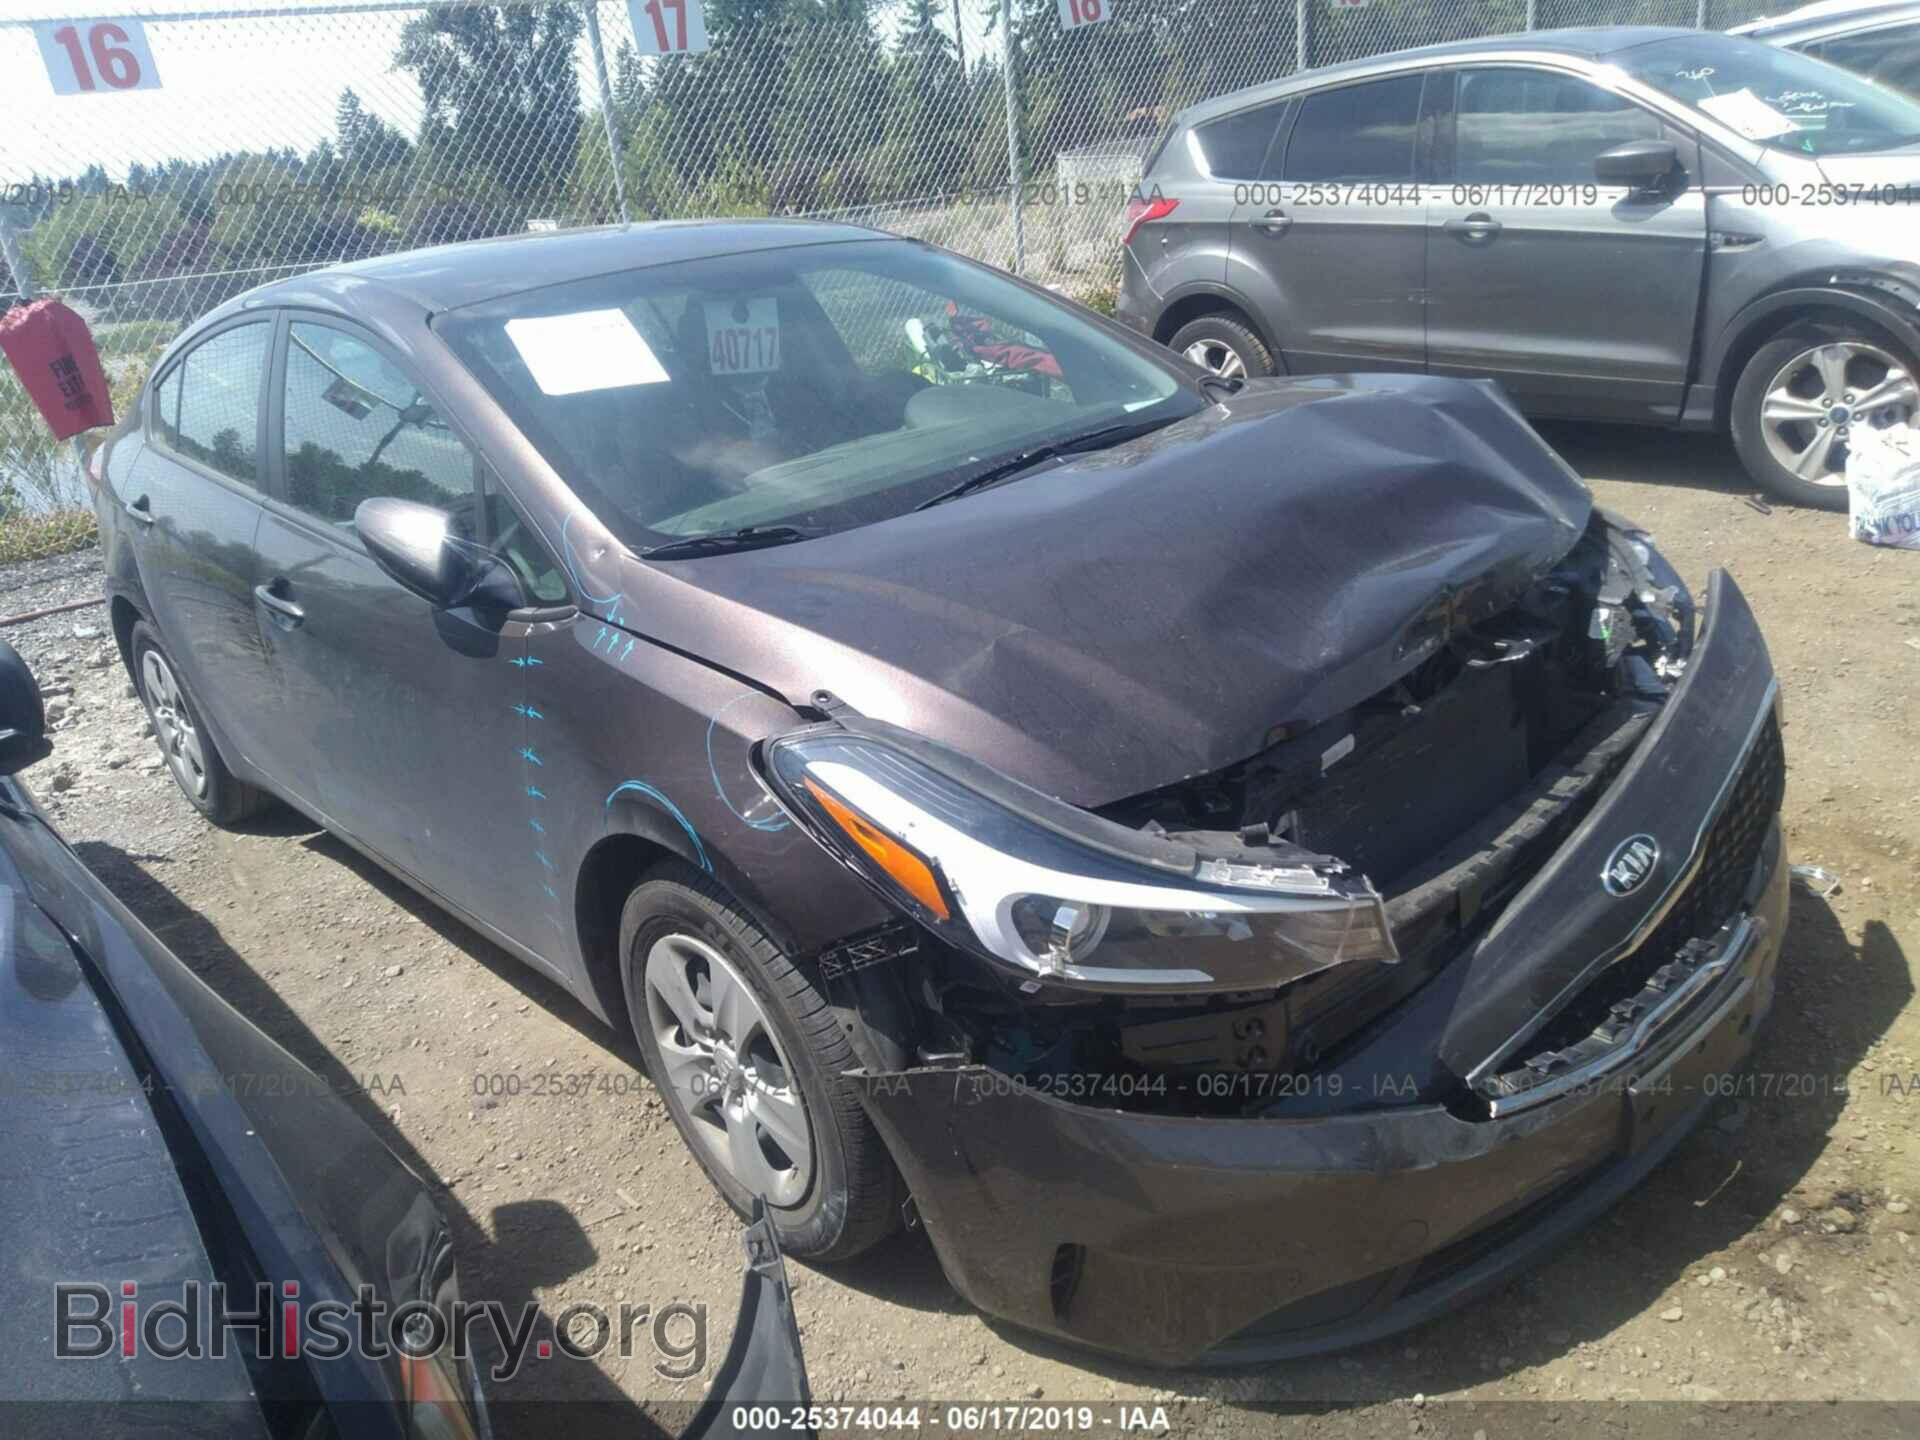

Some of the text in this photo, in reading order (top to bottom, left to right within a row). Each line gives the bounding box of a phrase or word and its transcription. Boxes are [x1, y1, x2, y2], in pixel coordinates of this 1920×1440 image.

[644, 0, 688, 52] 17
[54, 23, 140, 91] 16
[713, 327, 778, 371] 40717
[1609, 840, 1655, 890] KIA
